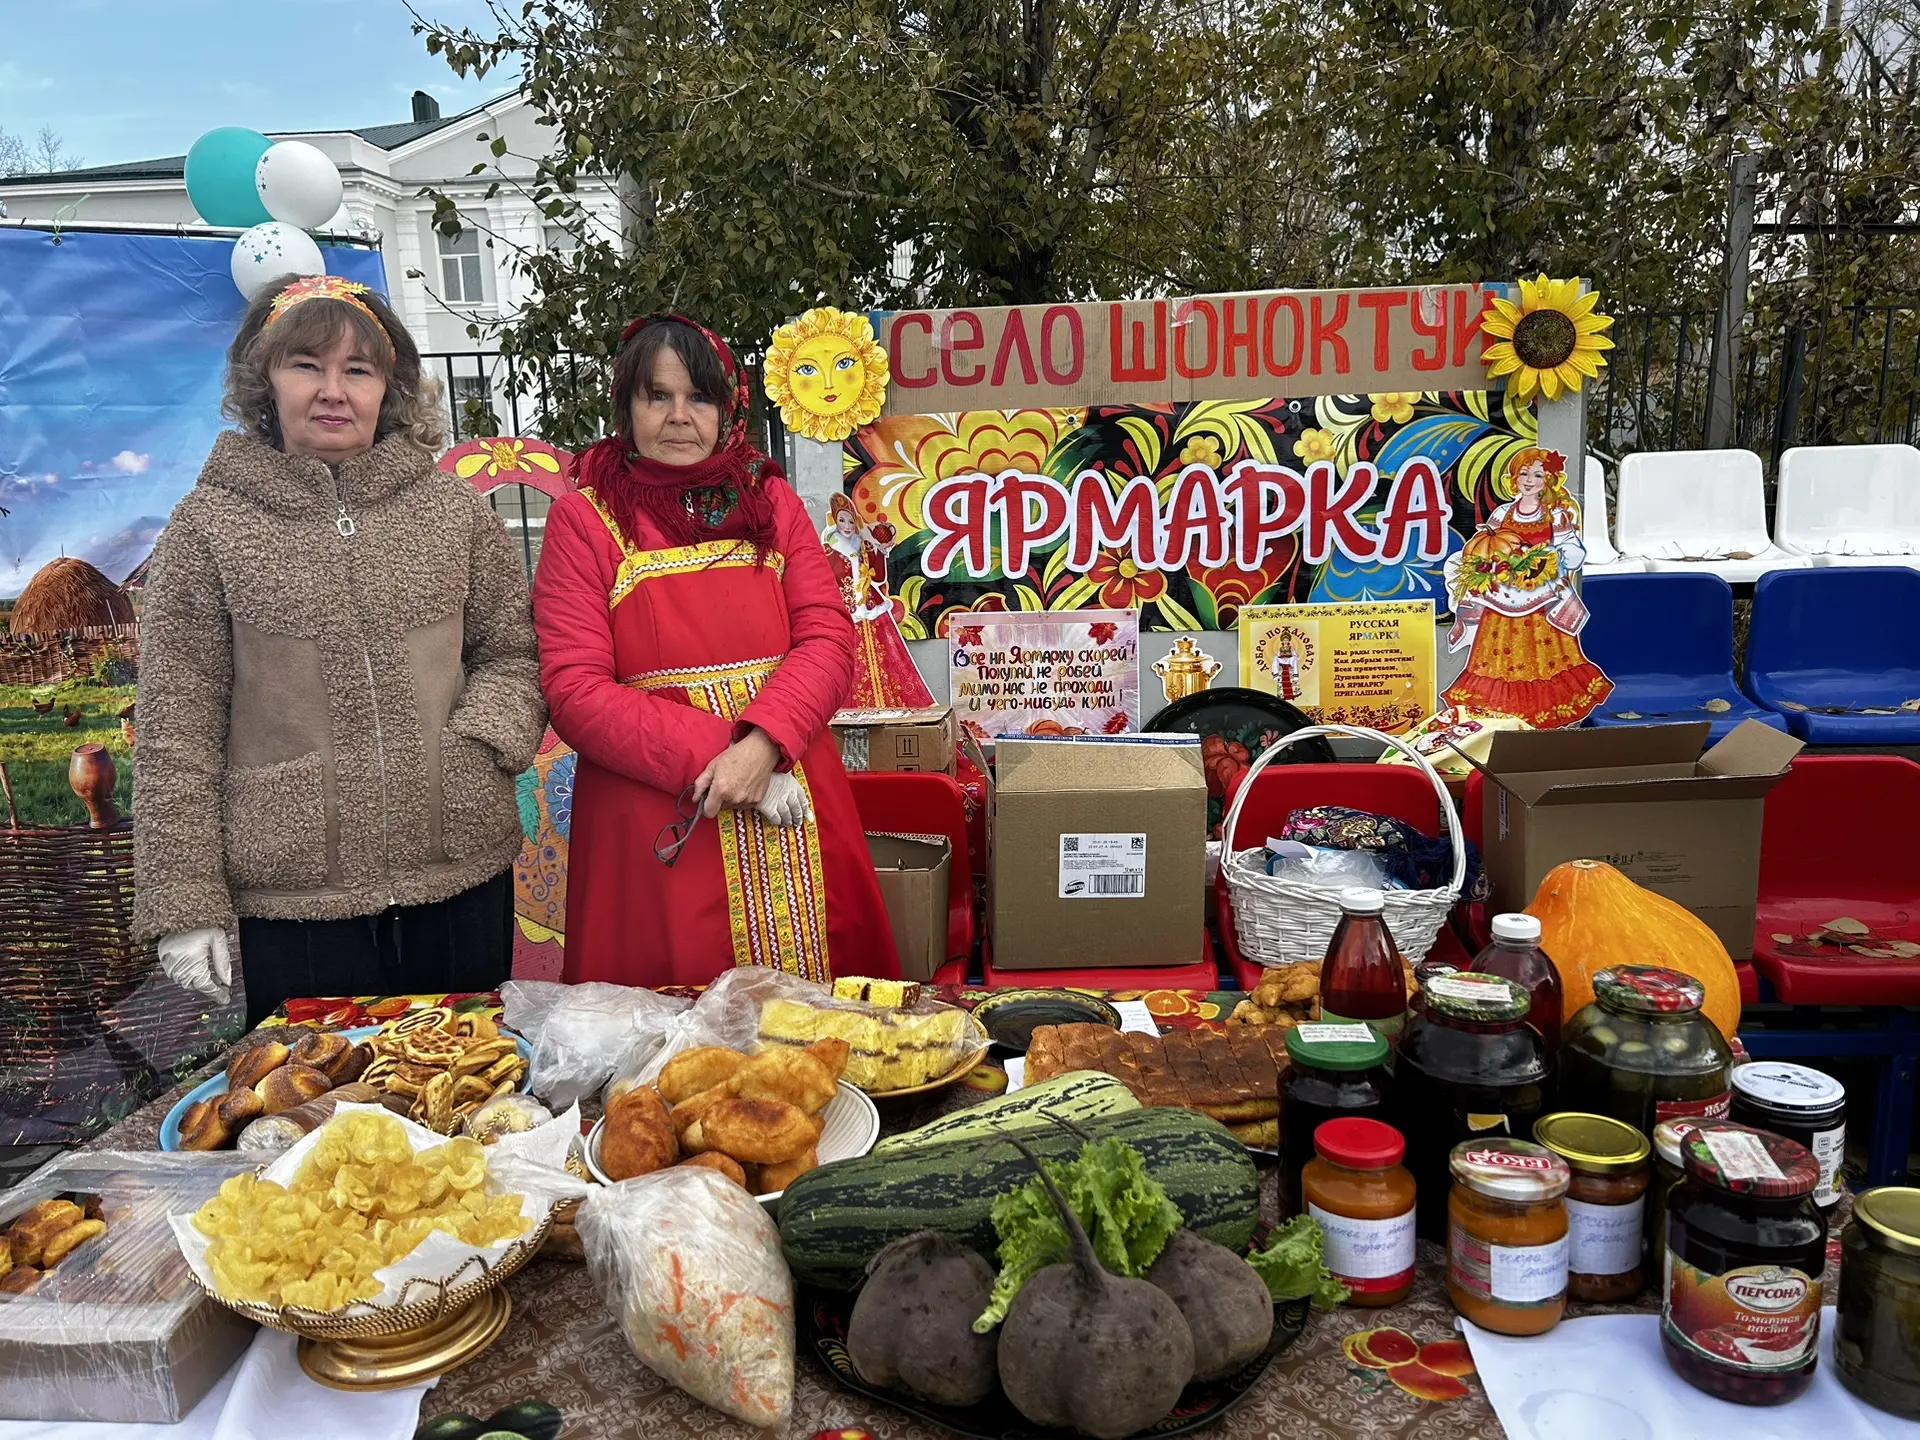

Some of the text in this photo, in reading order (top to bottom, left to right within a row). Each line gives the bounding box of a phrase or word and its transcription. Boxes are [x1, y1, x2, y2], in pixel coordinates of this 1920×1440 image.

[922, 459, 1451, 576] ЯРМАРКА
[1349, 619, 1399, 629] РУССКАЯ
[1348, 631, 1400, 641] ЯРМАРКА
[1255, 625, 1315, 672] ДОБРО ПОЖАЛОВАТЬ
[953, 648, 986, 667] Все
[990, 652, 1006, 665] на
[1036, 665, 1052, 679] не
[1057, 663, 1103, 681] робей
[1353, 665, 1398, 673] привечаем,
[1002, 682, 1025, 695] нас
[1031, 682, 1048, 694] не
[1053, 680, 1113, 696] проходи
[1333, 689, 1393, 697] ПРИГЛАШАЕМ!
[986, 696, 1076, 711] чего-нибудь
[1735, 1285, 1800, 1299] ПЕРСОНА
[1734, 1311, 1800, 1325] Томатная
[1747, 1324, 1789, 1334] паста
